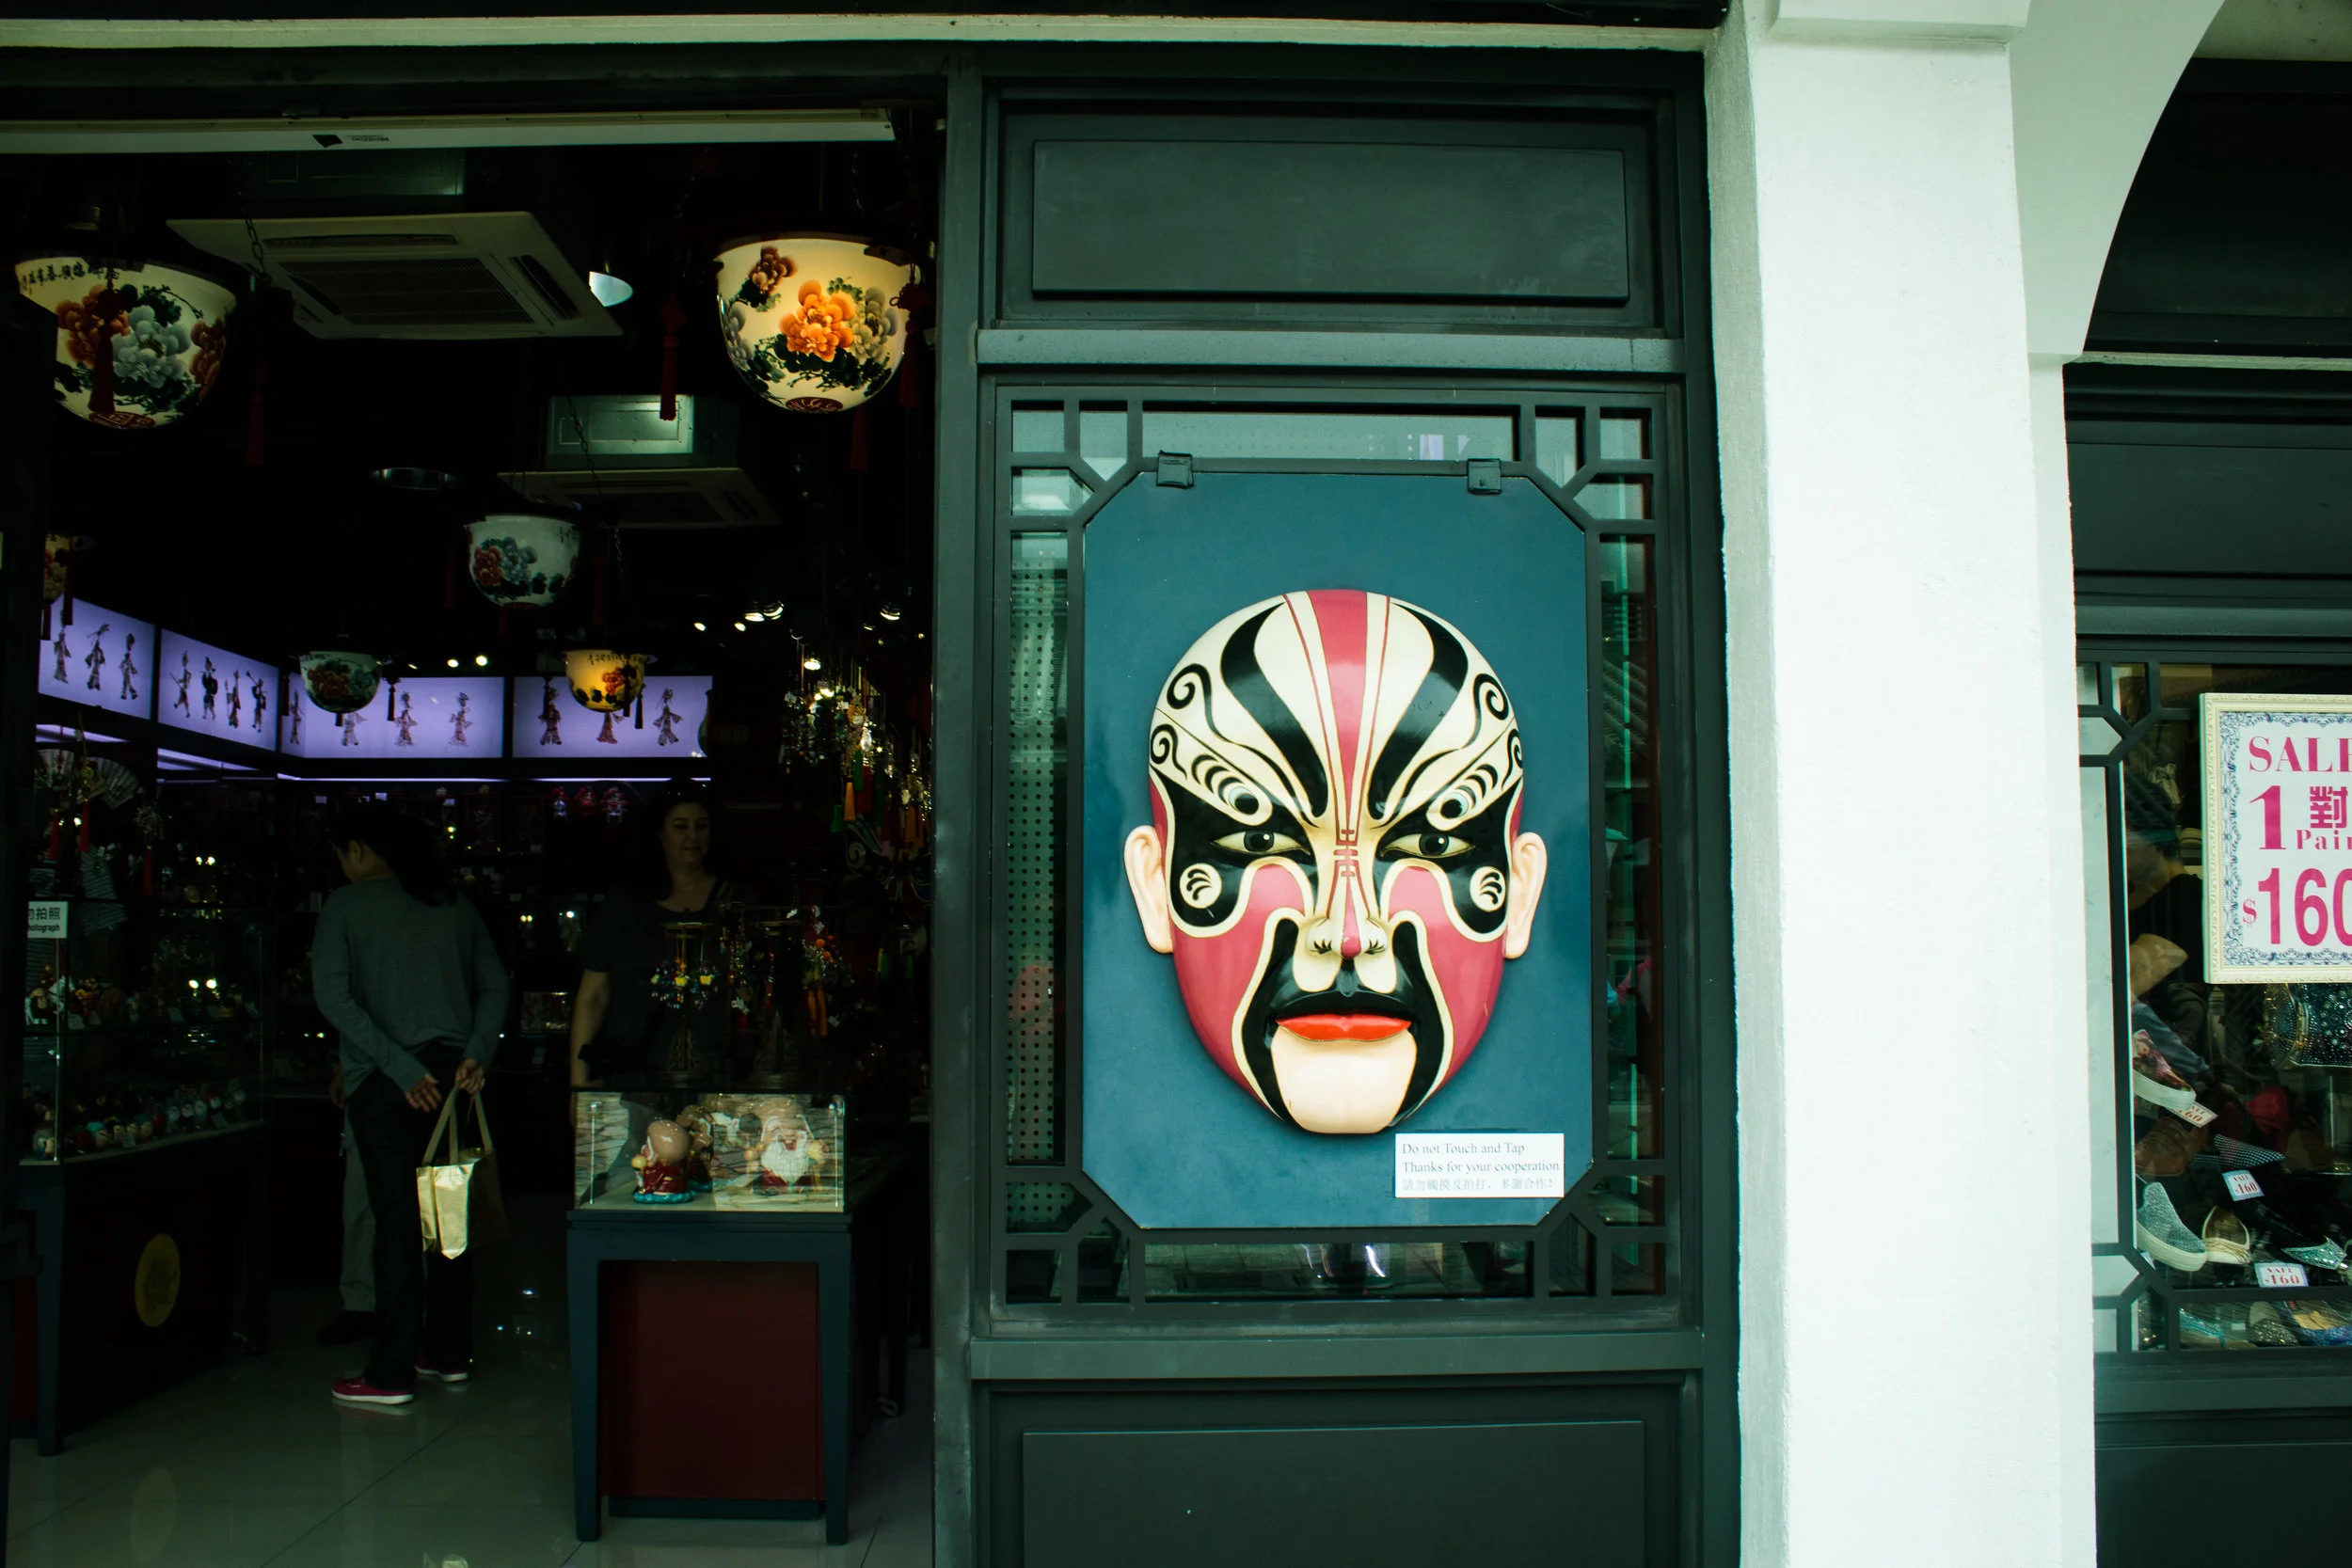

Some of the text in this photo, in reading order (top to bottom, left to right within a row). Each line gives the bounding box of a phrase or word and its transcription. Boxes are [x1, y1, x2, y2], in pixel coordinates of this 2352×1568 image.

[2249, 785, 2348, 849] 1 對
[1402, 1142, 1525, 1155] Do not Touch and Tap
[1403, 1161, 1560, 1174] Thanks for your cooperation
